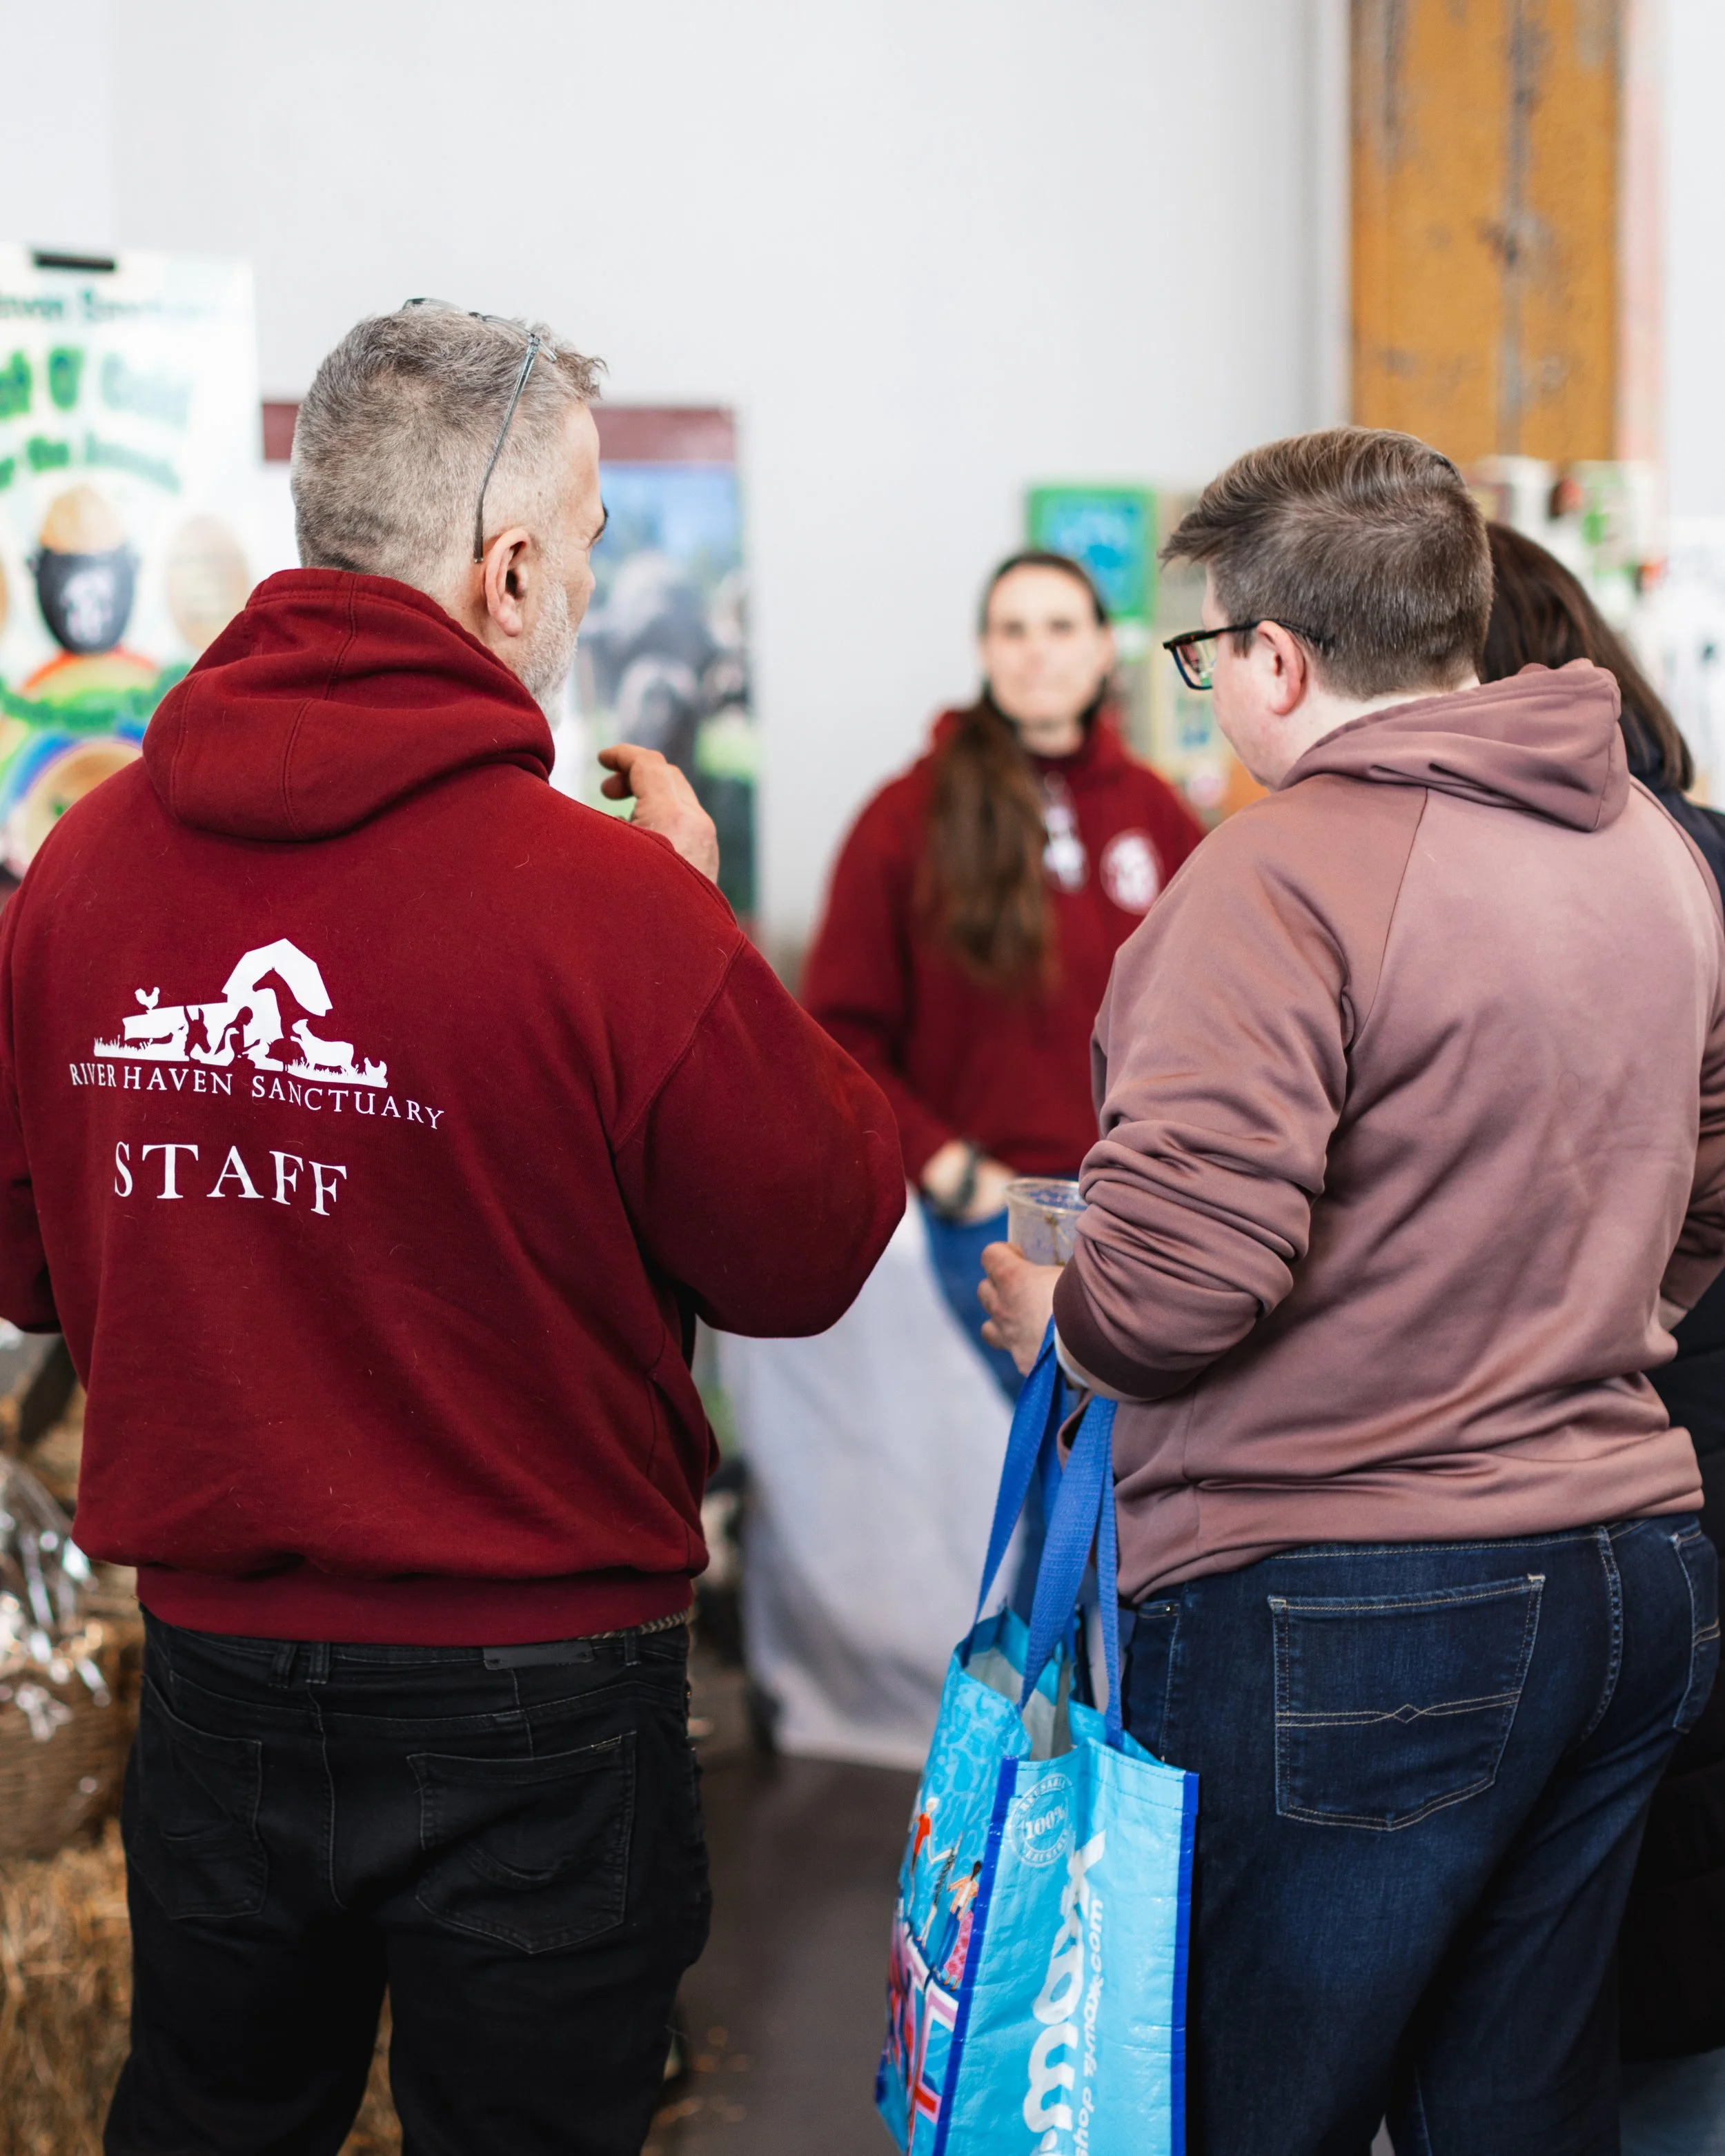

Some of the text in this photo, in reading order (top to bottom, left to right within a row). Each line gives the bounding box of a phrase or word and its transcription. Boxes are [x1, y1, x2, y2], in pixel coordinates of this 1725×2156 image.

[69, 1062, 445, 1130] RIVER HAVEN SANCTUARY
[114, 1141, 348, 1216] STAFF
[1073, 2086, 1095, 2156] shop
